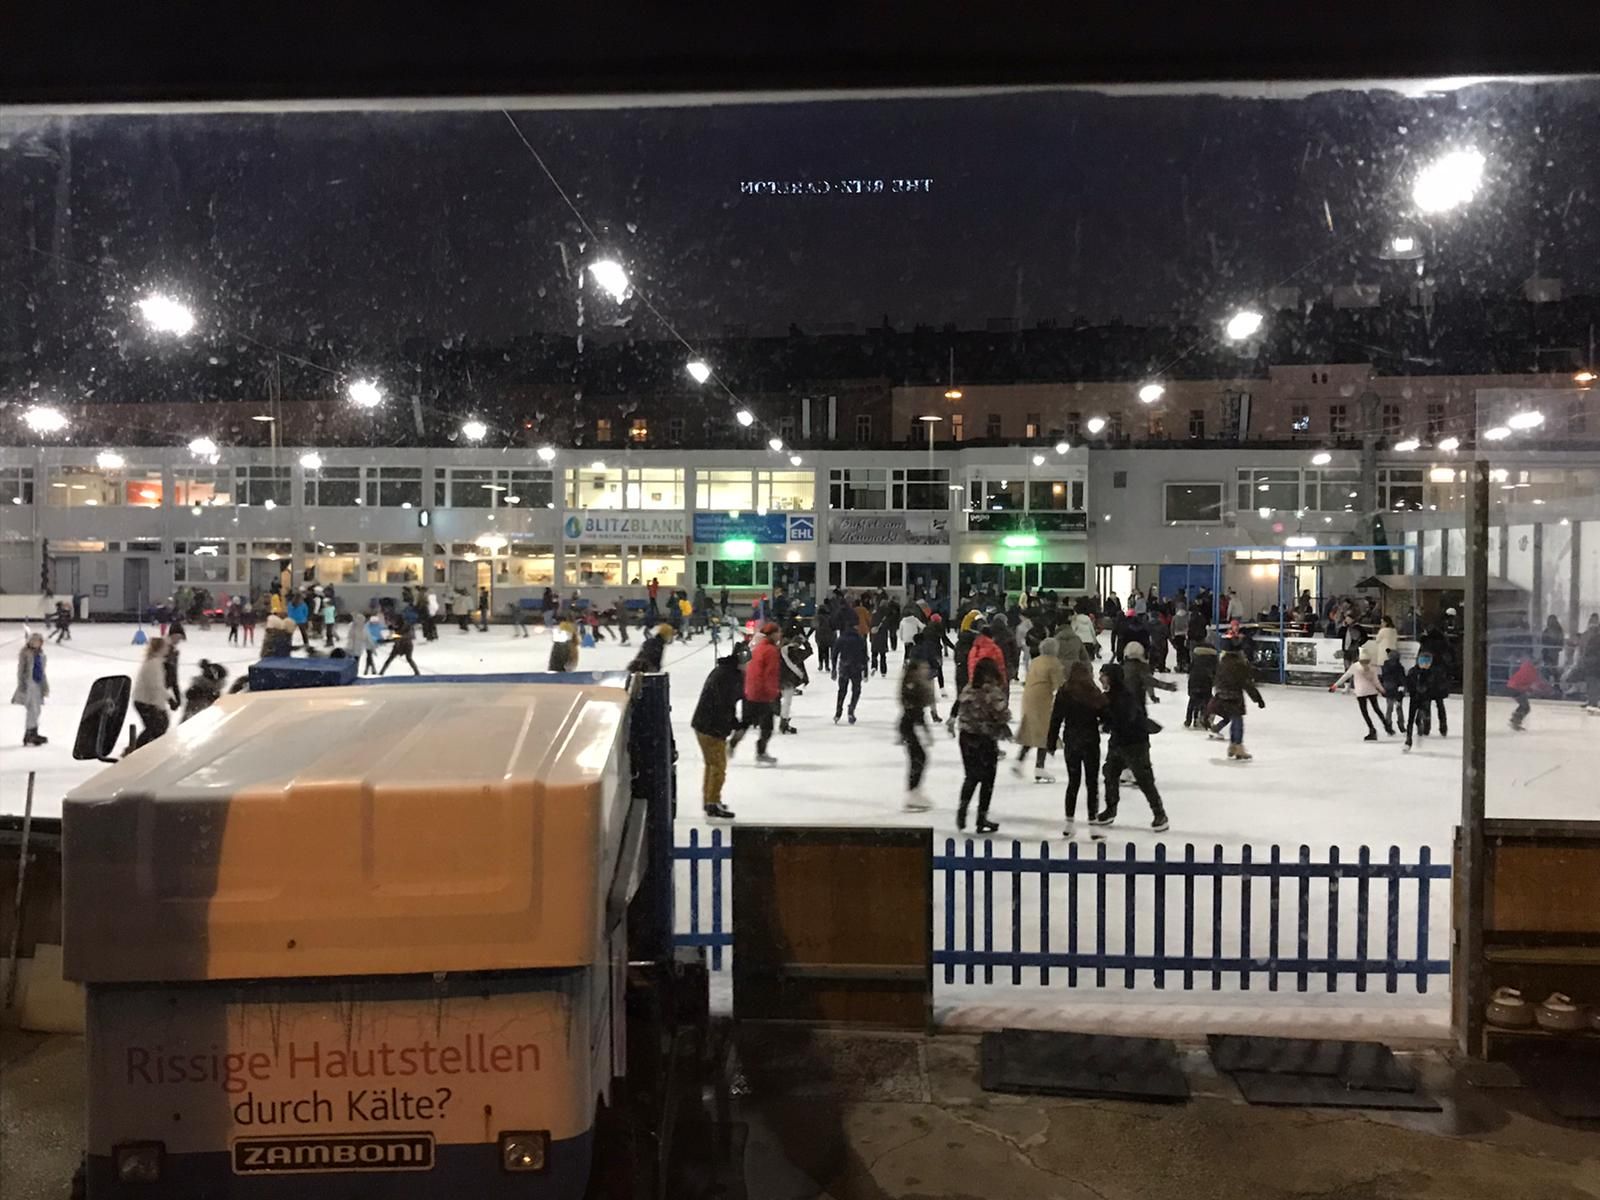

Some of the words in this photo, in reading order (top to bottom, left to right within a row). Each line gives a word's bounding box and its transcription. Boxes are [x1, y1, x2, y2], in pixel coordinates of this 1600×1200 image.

[585, 518, 684, 533] BLITZBLANK
[791, 528, 814, 539] EHL
[126, 1045, 271, 1093] Rissige
[288, 1033, 541, 1079] Hautstellen
[233, 1091, 333, 1125] durch
[347, 1087, 452, 1121] Kälte?
[243, 1143, 424, 1167] ZAMBONI
